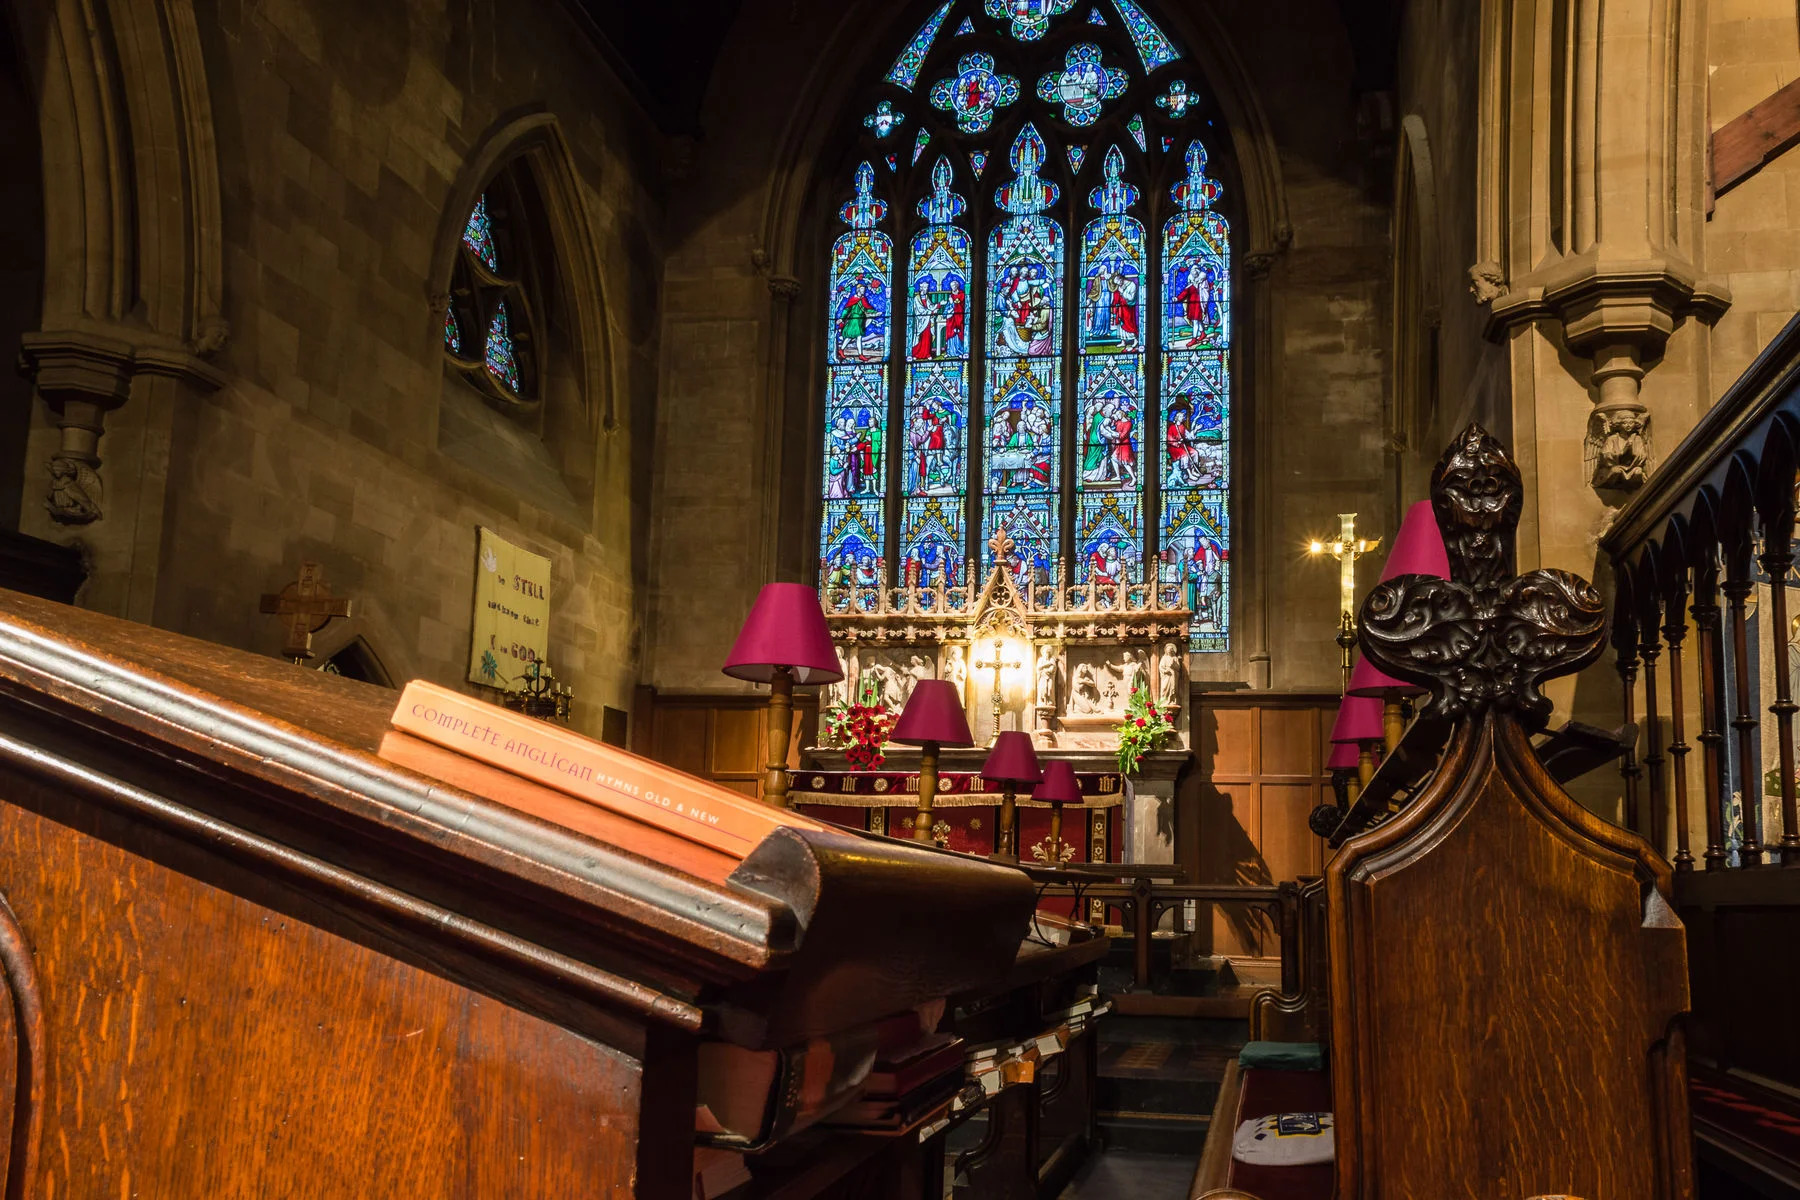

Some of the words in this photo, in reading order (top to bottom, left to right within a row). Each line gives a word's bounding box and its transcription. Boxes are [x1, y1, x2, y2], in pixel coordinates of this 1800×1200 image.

[513, 574, 545, 601] STILL
[511, 641, 536, 663] GOD
[412, 703, 501, 747] COMPLETE
[504, 739, 593, 781] ANGLICAN
[596, 772, 640, 796] HYMNS
[644, 791, 671, 807] OLD
[675, 803, 685, 813] &
[690, 807, 720, 825] NEW
